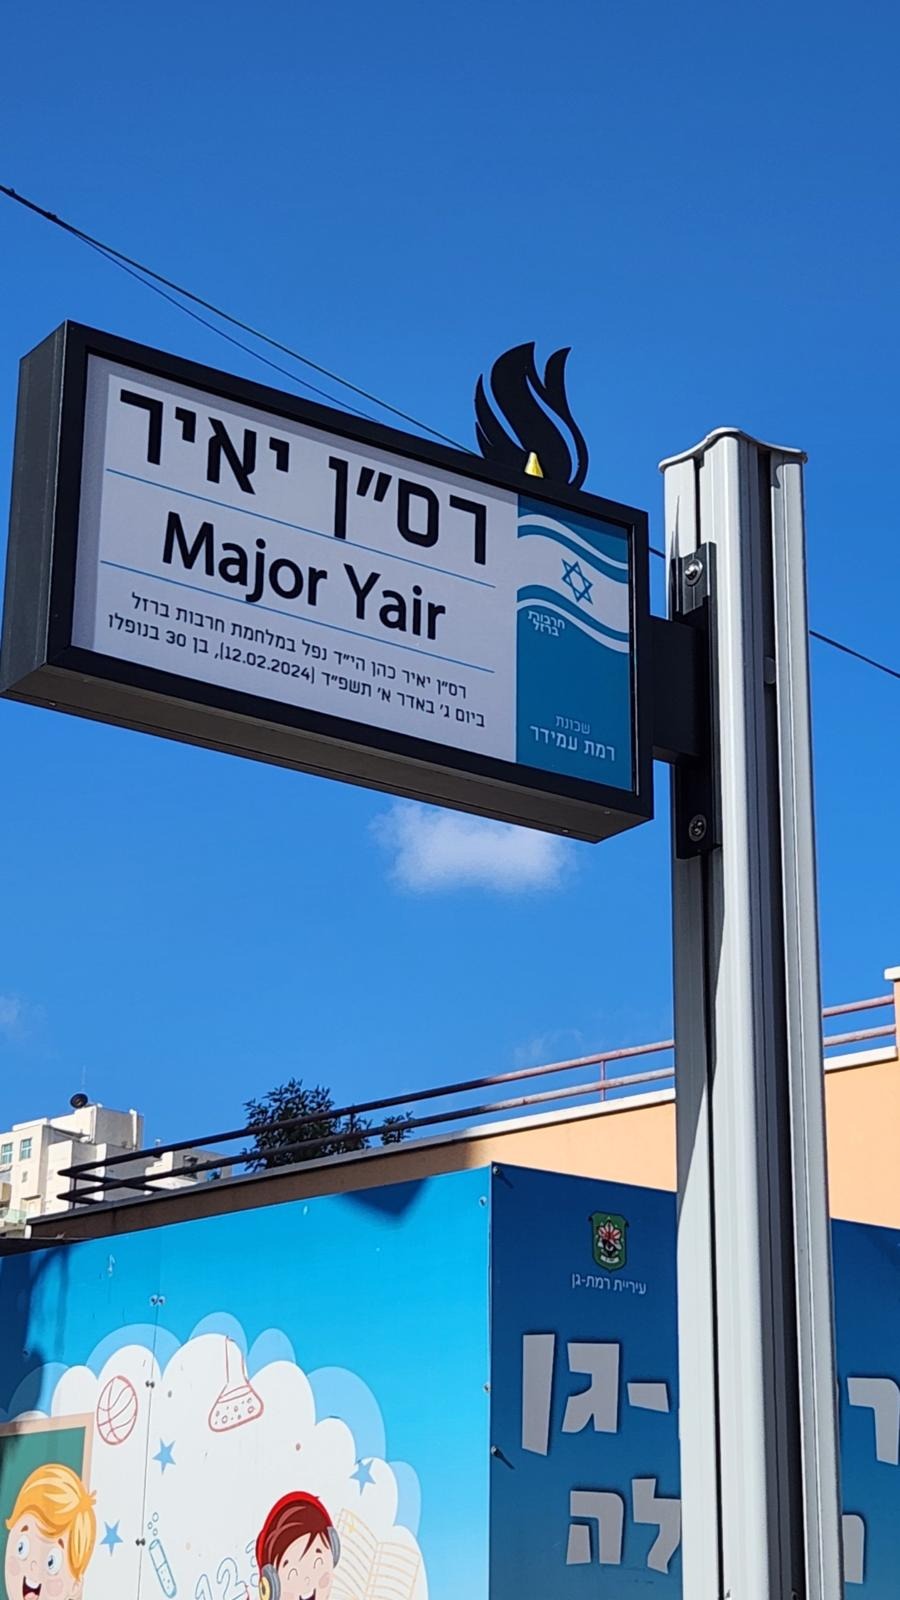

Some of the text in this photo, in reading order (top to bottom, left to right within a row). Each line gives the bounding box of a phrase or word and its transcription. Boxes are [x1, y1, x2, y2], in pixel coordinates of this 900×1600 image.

[120, 388, 487, 565] רס"ן יאיר
[162, 510, 446, 640] Major Yair
[131, 591, 170, 618] ברזל
[108, 612, 160, 641] בנופלו
[175, 607, 225, 633] חרבות
[527, 610, 566, 630] חרבות
[532, 618, 560, 637] ברזל
[165, 630, 187, 647] 30
[192, 636, 209, 654] בן
[230, 622, 297, 653] במלחמת
[301, 638, 328, 661] נפל
[371, 661, 396, 680] כהן
[402, 669, 431, 689] יאיר
[396, 691, 435, 714] באדר
[455, 707, 485, 728] ביום
[555, 714, 591, 735] שכונת
[530, 725, 615, 762] רמת עמידר
[571, 1273, 647, 1295] עיריית רמת-גן
